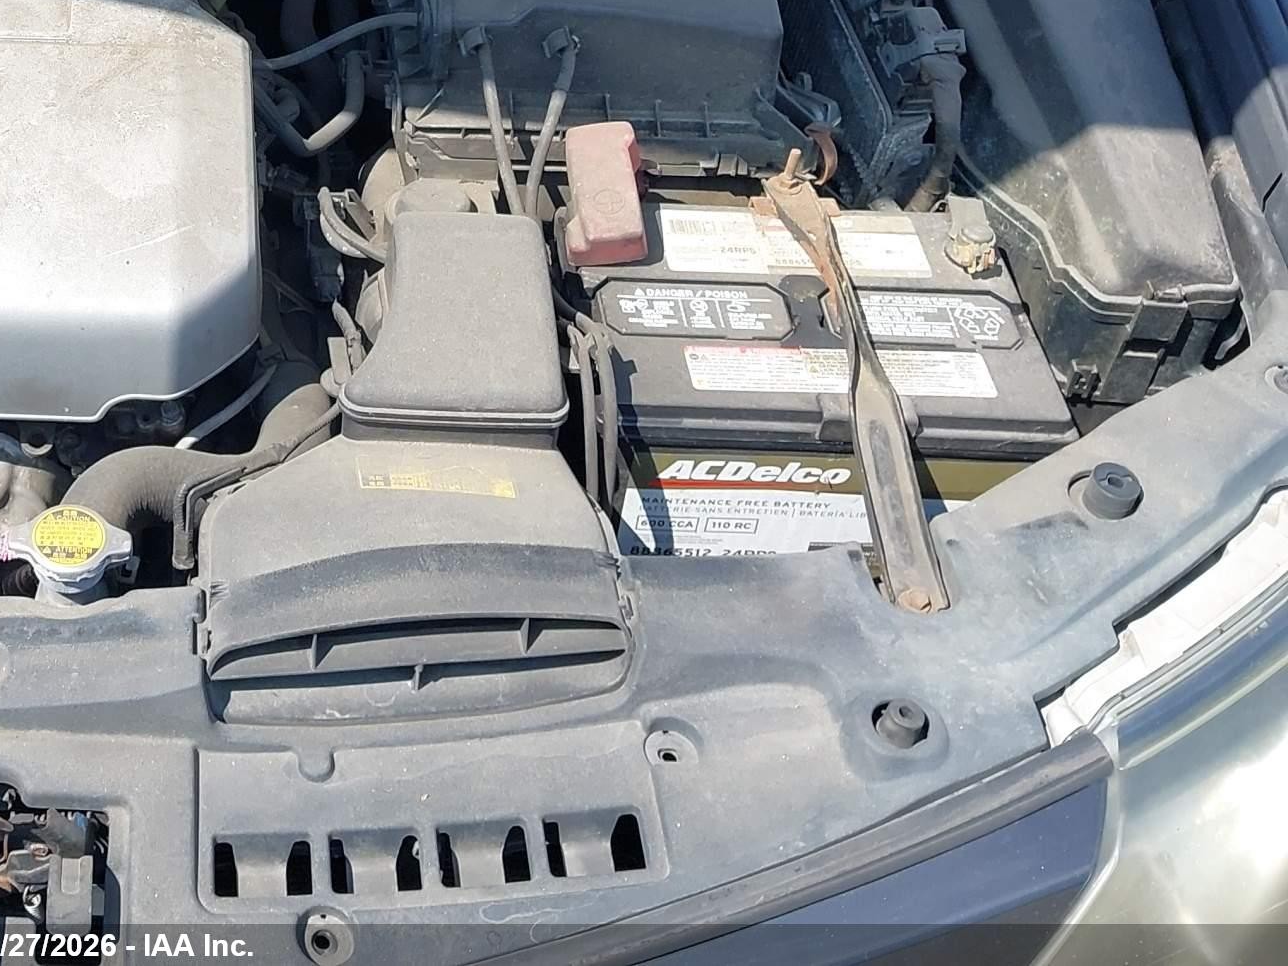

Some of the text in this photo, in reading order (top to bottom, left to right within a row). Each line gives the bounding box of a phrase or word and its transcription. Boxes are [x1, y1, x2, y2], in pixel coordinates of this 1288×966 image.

[645, 288, 694, 298] DANGER
[704, 289, 748, 299] POISON
[657, 460, 851, 485] ACDelco
[641, 497, 832, 510] MAINTENANCE FREE BATTERY
[695, 506, 723, 514] SANS
[727, 507, 788, 516] ENTRETIEN
[55, 514, 92, 523] CAUTION
[669, 520, 694, 529] CCA
[712, 521, 731, 530] 110
[734, 522, 752, 530] RC
